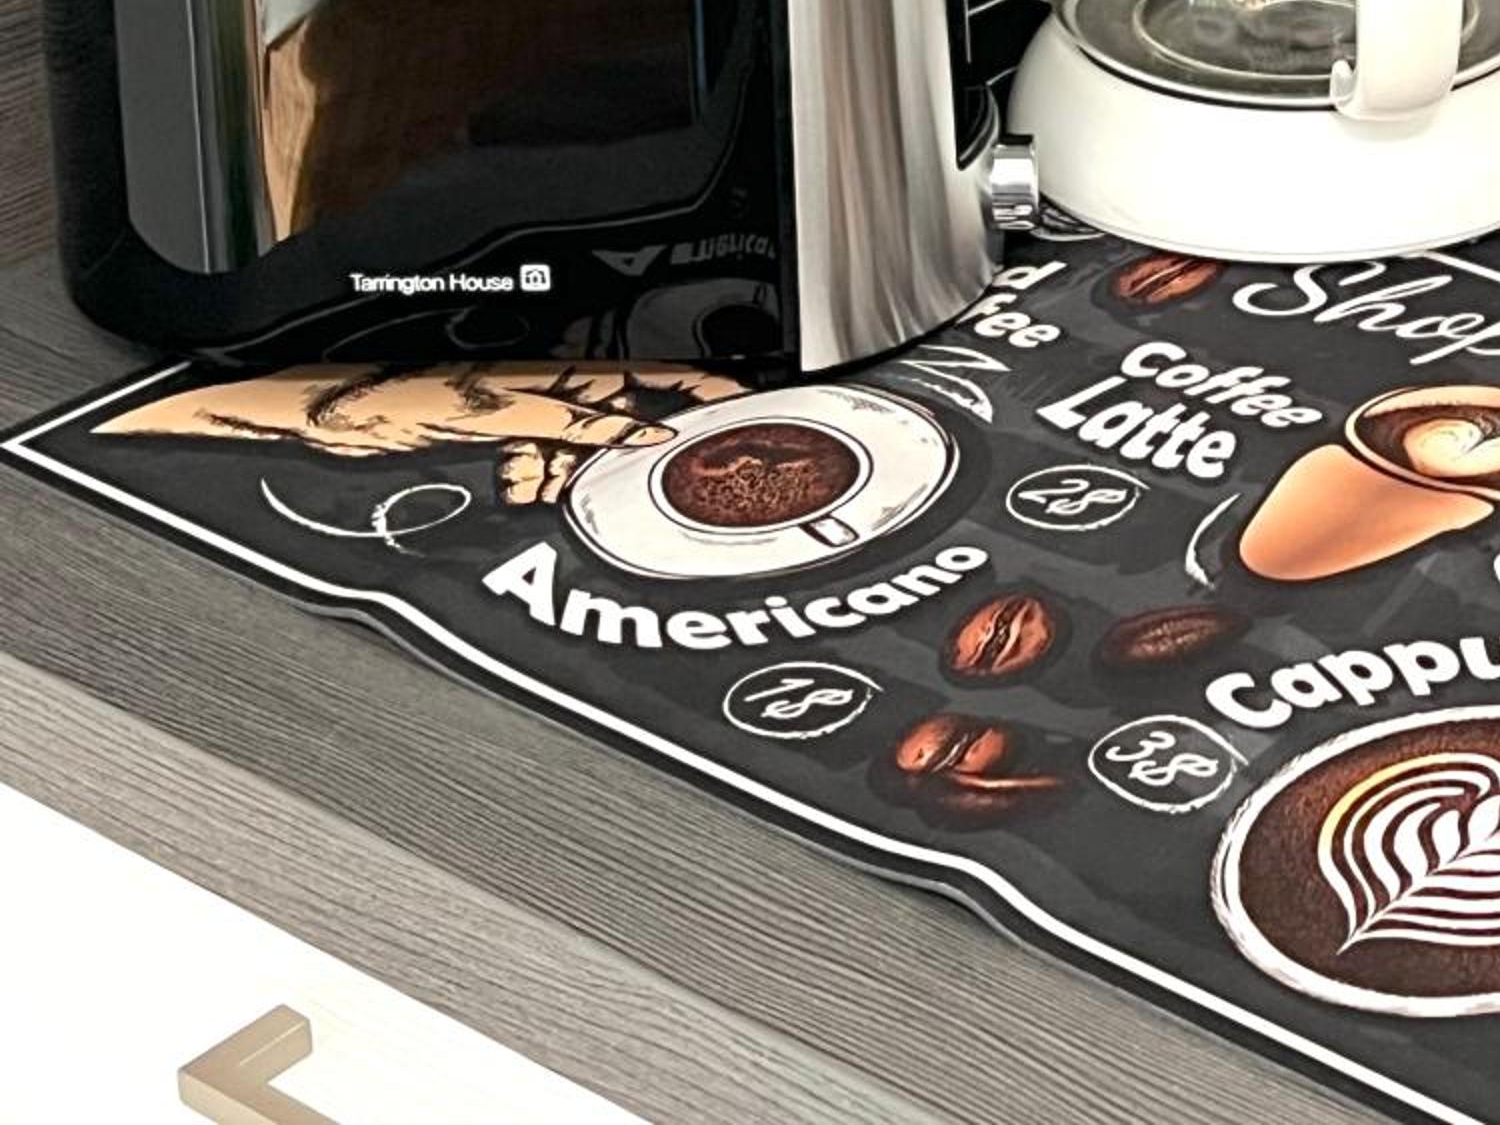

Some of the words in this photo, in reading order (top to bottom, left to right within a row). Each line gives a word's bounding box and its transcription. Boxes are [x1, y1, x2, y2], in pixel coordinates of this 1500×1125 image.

[349, 273, 446, 296] Tarrington
[449, 273, 514, 292] House
[956, 292, 1061, 348] fee
[1119, 338, 1327, 432] Coffee
[1035, 375, 1240, 480] Latte
[481, 539, 992, 652] Americano
[1105, 730, 1221, 803] 3$
